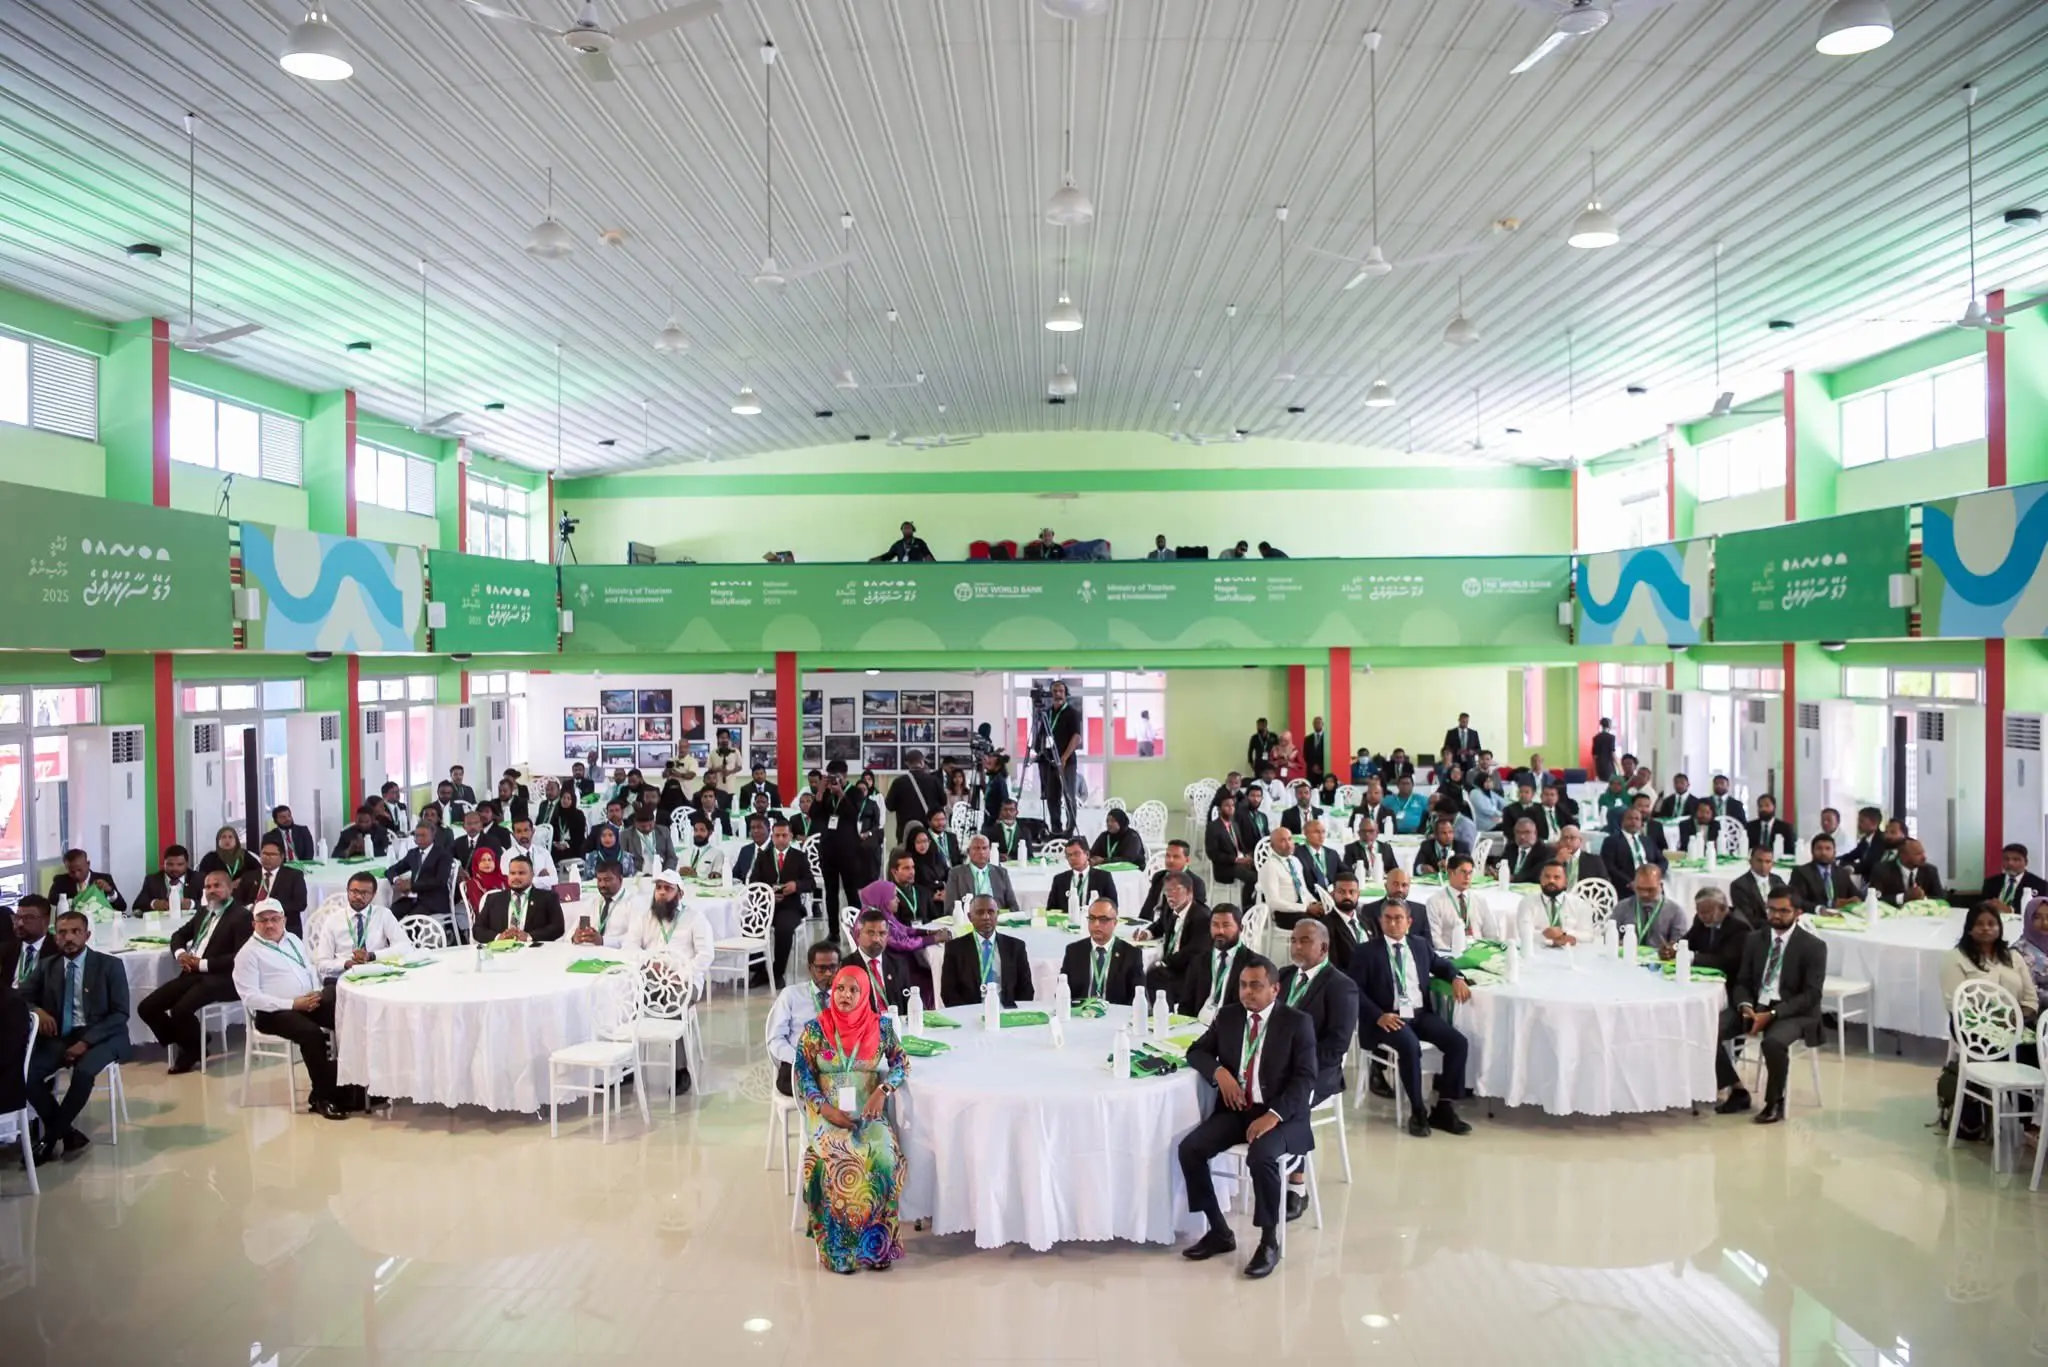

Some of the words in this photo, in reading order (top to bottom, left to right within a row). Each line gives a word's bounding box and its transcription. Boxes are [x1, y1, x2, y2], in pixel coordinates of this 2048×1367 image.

[42, 588, 69, 602] 2025
[974, 586, 989, 594] THE
[990, 585, 1020, 594] WORLD
[1020, 586, 1043, 594] BANK
